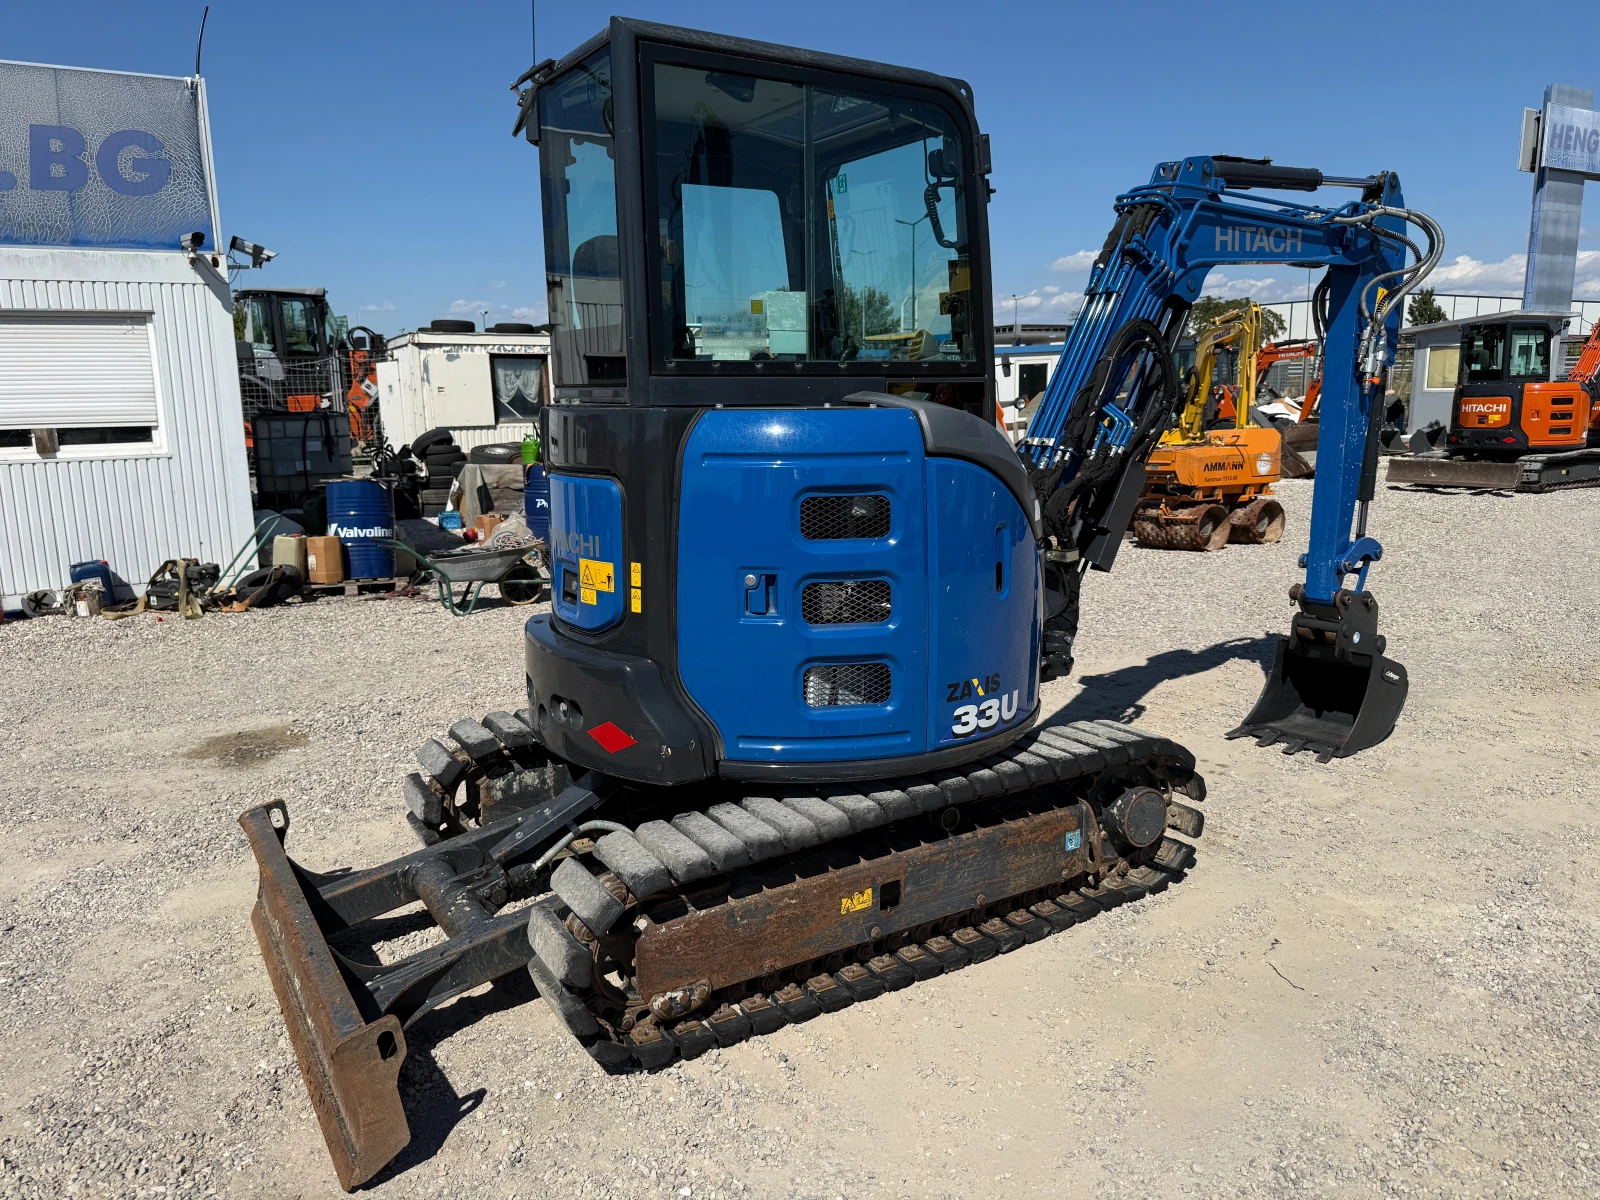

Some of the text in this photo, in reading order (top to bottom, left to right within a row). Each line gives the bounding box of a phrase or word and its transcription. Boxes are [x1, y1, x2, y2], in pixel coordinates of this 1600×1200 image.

[1549, 122, 1600, 154] HENG
[1214, 225, 1303, 253] HITACH
[1461, 403, 1507, 413] HITACHI
[1203, 461, 1244, 472] AMMANN
[337, 526, 393, 538] Valvoline
[951, 688, 1019, 738] 33U
